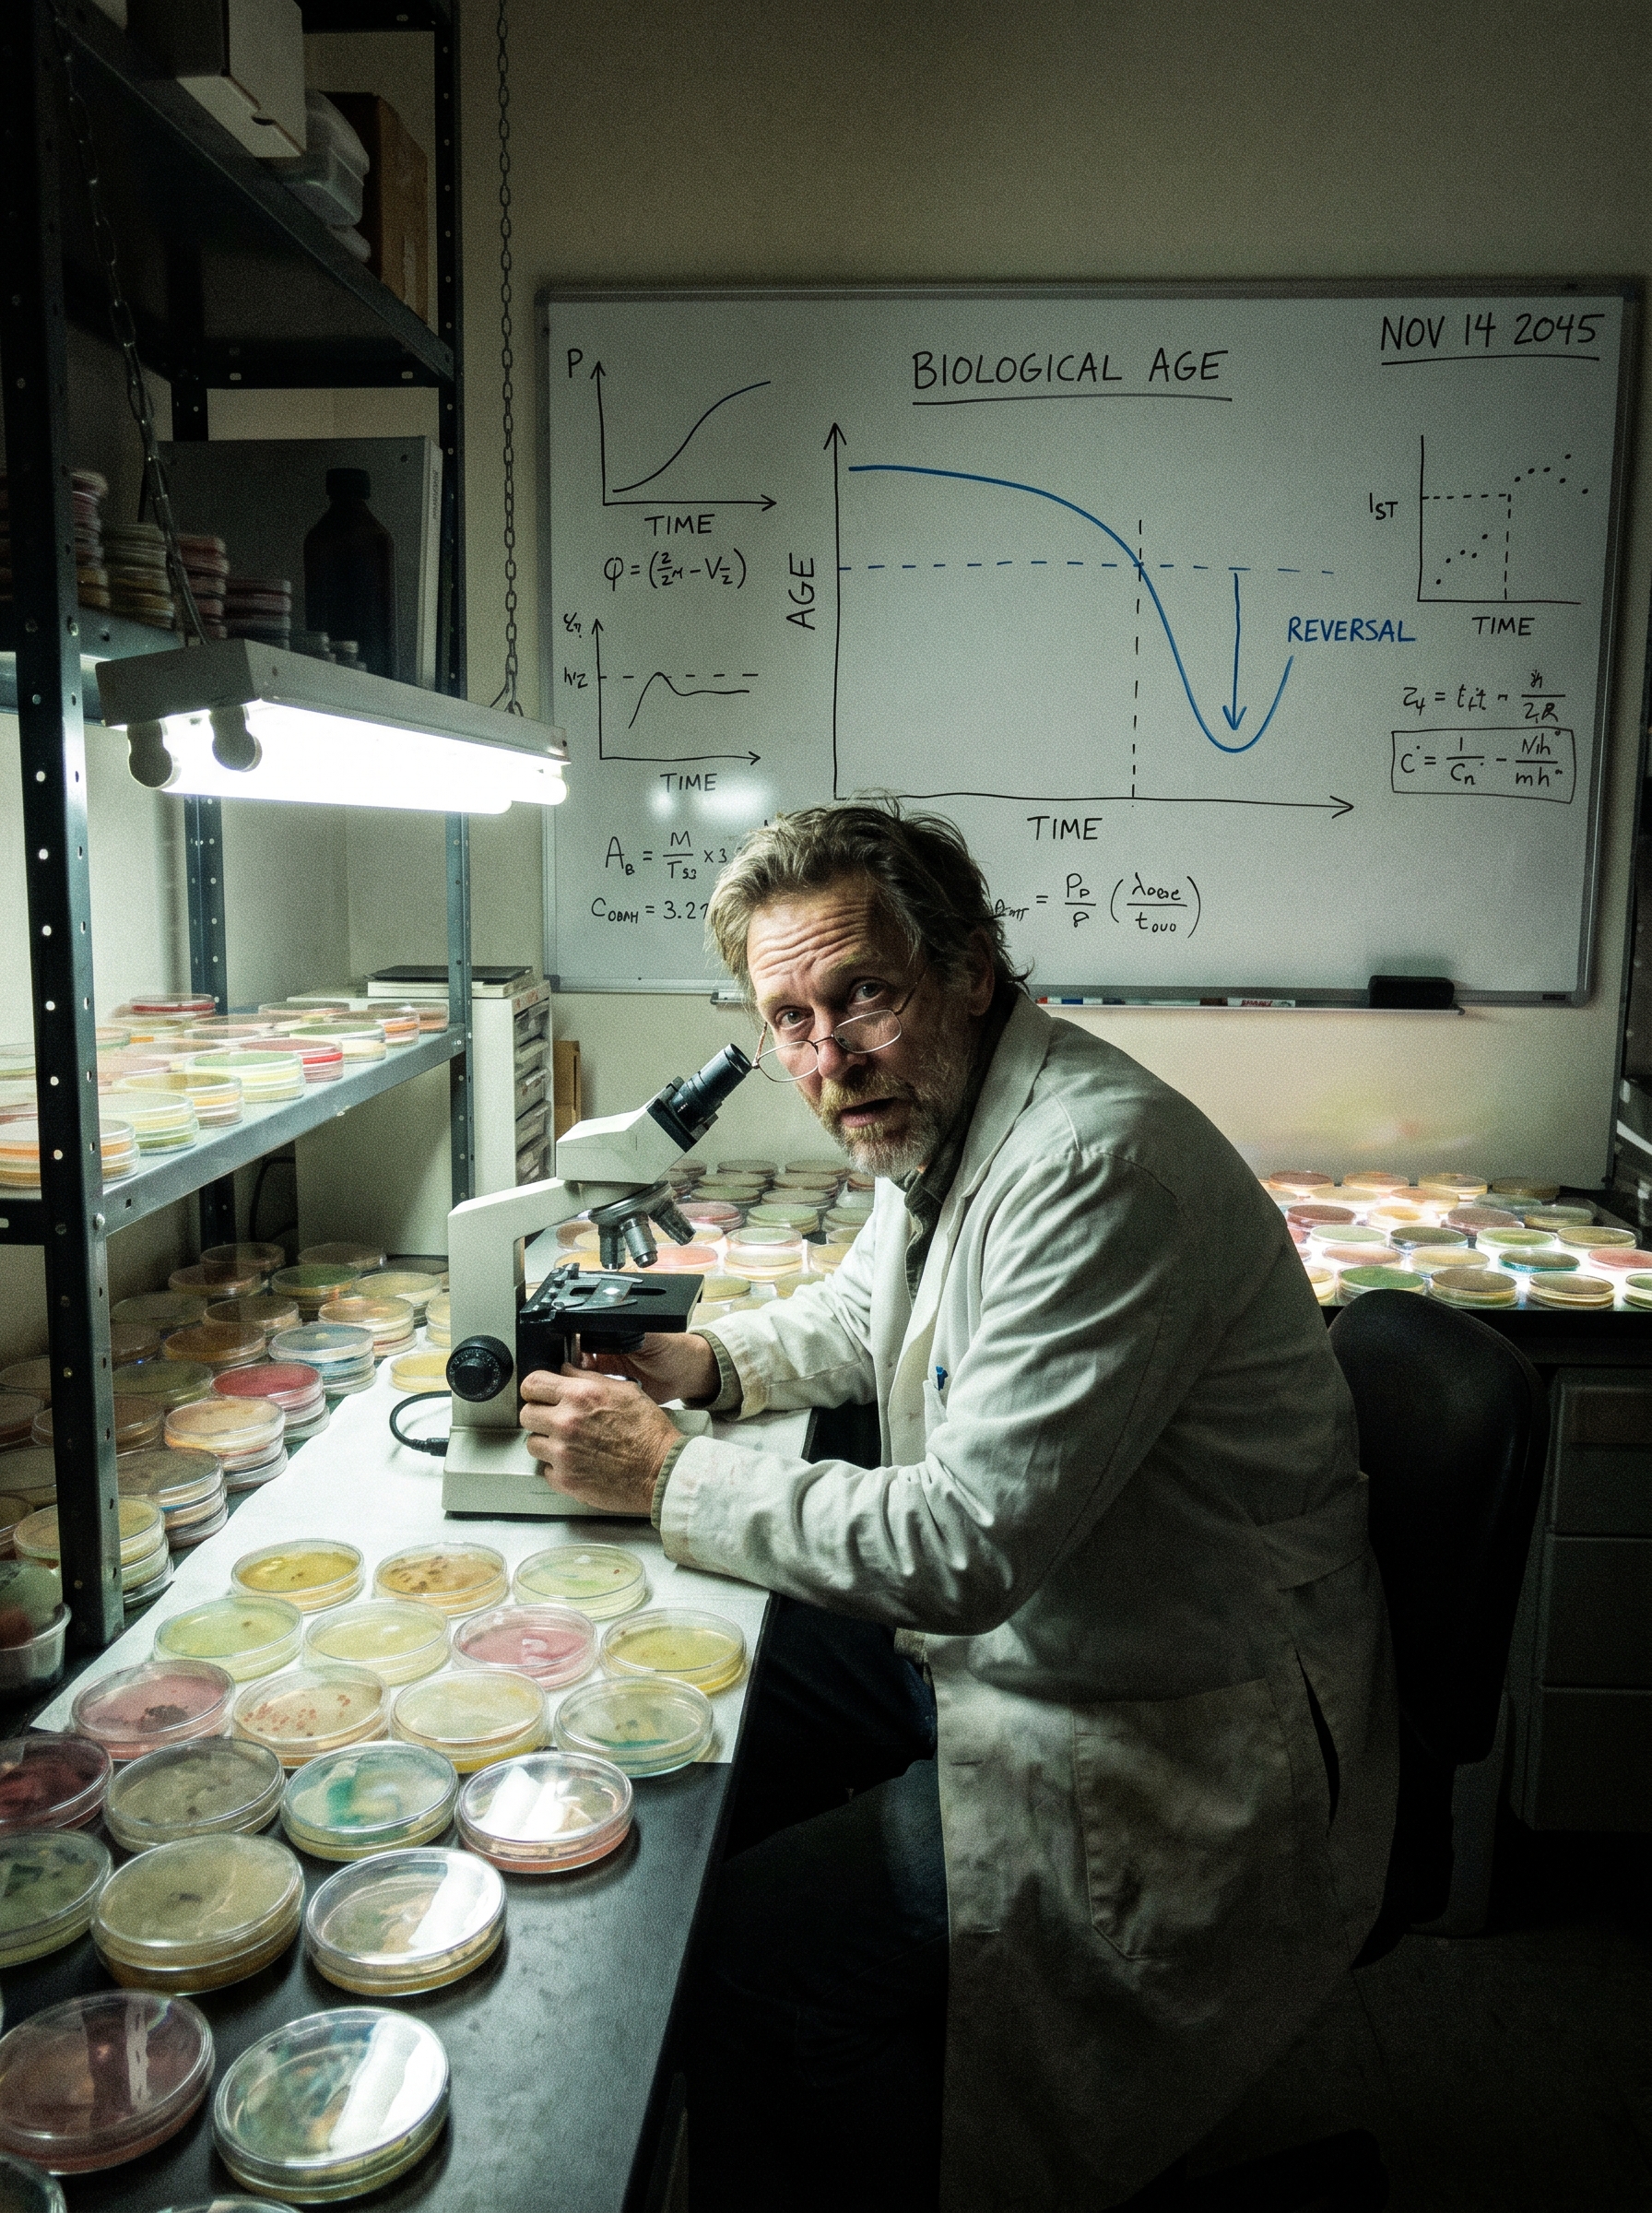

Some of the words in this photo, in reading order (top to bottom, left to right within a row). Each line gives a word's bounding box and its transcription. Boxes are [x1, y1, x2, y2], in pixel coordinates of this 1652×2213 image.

[1381, 314, 1446, 351] NOV
[1465, 312, 1497, 348] 14
[1514, 313, 1606, 346] 2045
[567, 348, 584, 379] P
[912, 350, 1123, 390] BIOLOGICAL
[1148, 347, 1229, 383] AGE
[643, 514, 715, 537] TIME
[785, 551, 816, 631] AGE
[1287, 616, 1417, 643] REVERSAL
[1471, 617, 1536, 636] TIME
[660, 772, 717, 793] TIME
[1026, 816, 1103, 841] TIME
